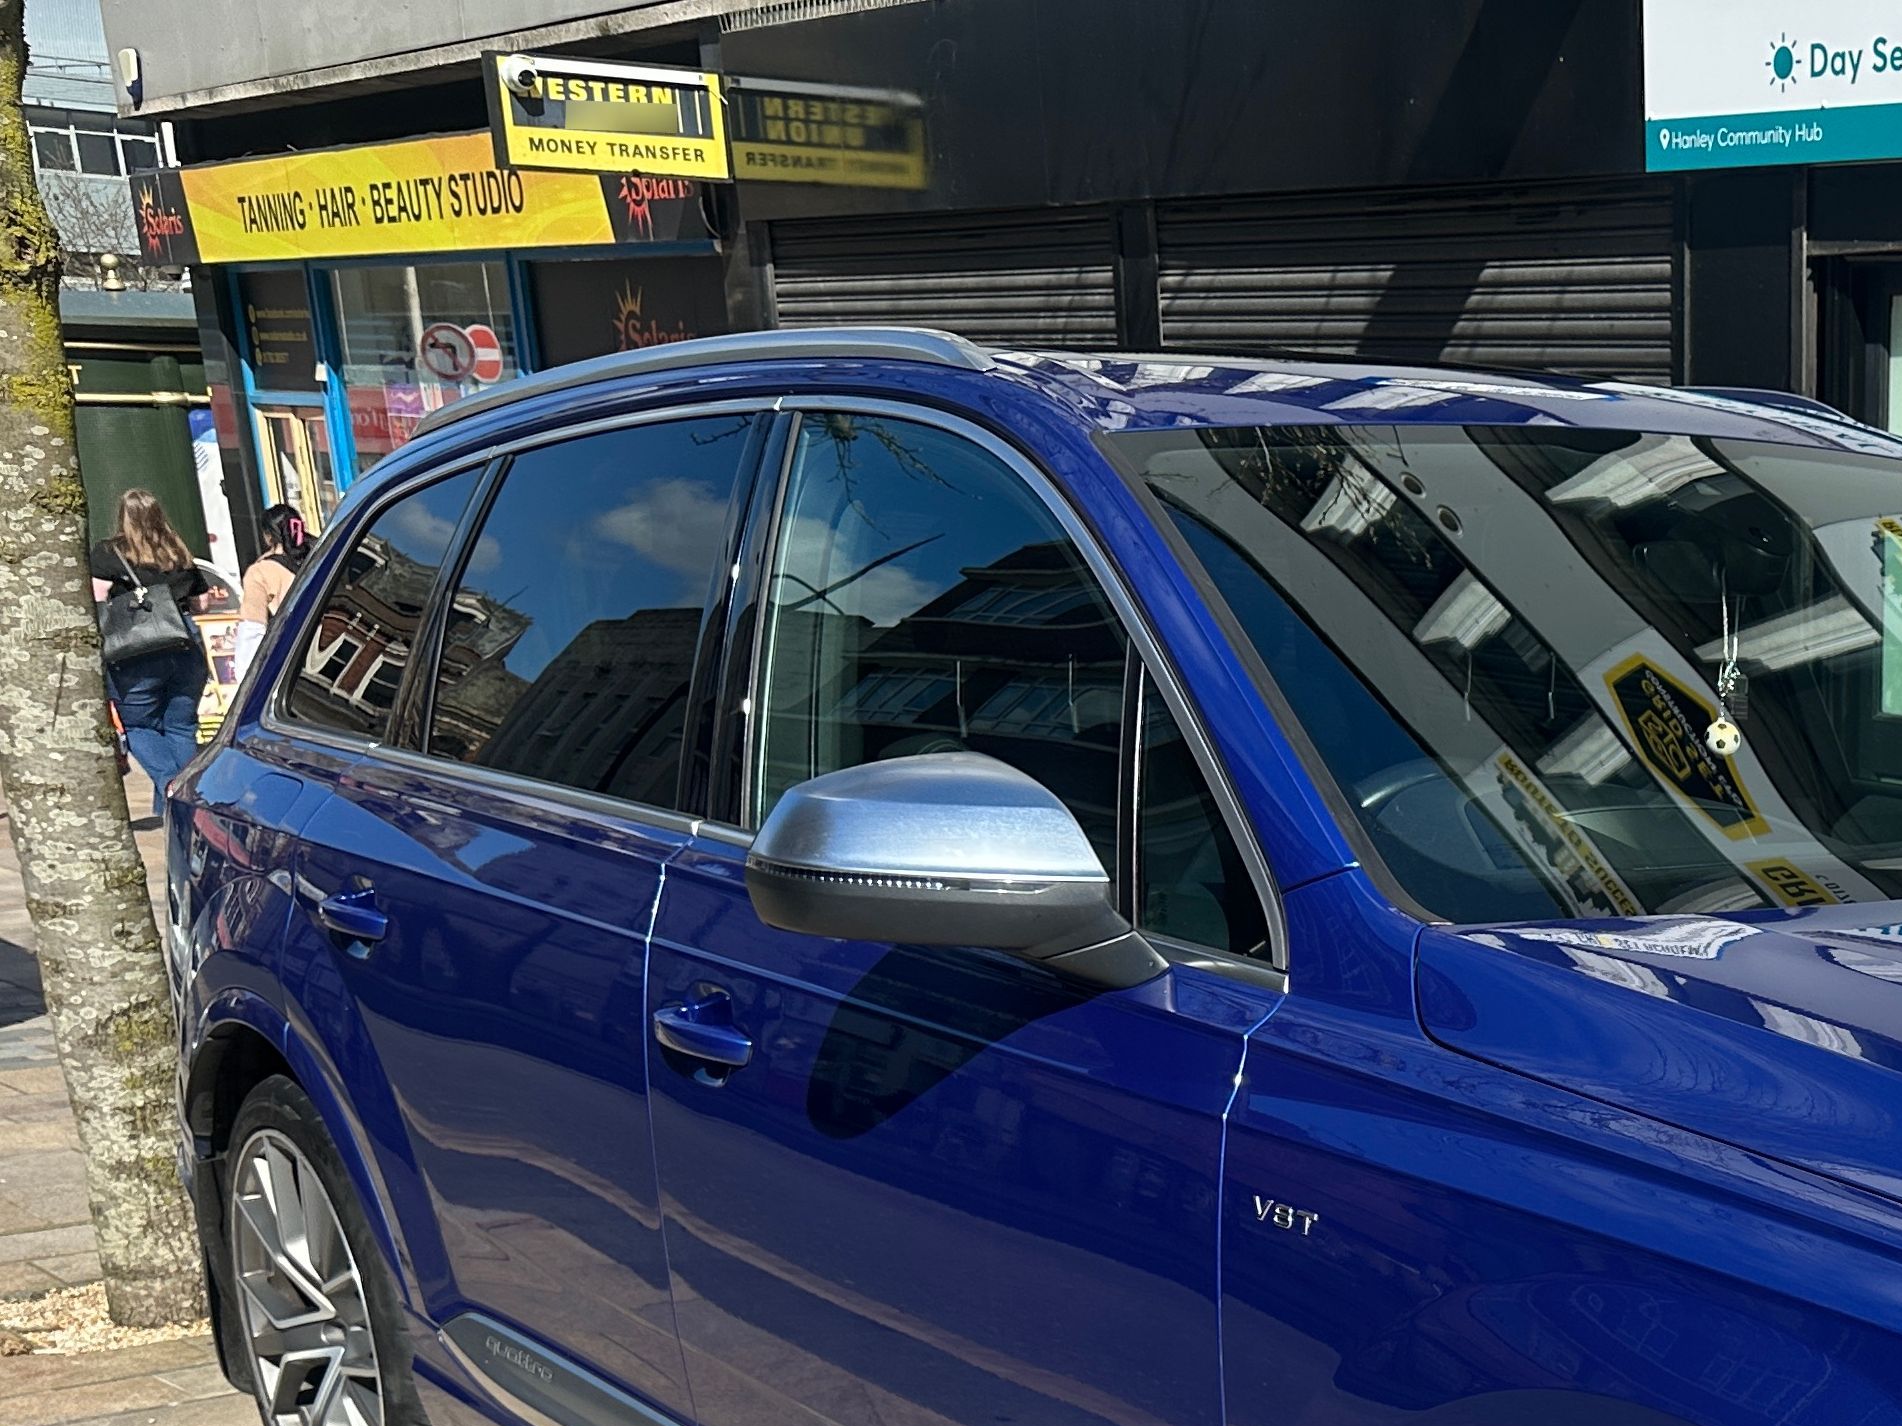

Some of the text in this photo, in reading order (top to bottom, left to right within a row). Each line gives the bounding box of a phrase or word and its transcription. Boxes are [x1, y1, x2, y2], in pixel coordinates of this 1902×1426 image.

[1810, 43, 1863, 84] Day
[528, 136, 706, 163] MONEY TRANSFER
[1672, 122, 1823, 152] Hanley Community Hub
[144, 202, 184, 237] Solaris
[237, 168, 525, 234] TANNING HAIR BEAUTY STUDIO
[1252, 1194, 1319, 1236] V8T
